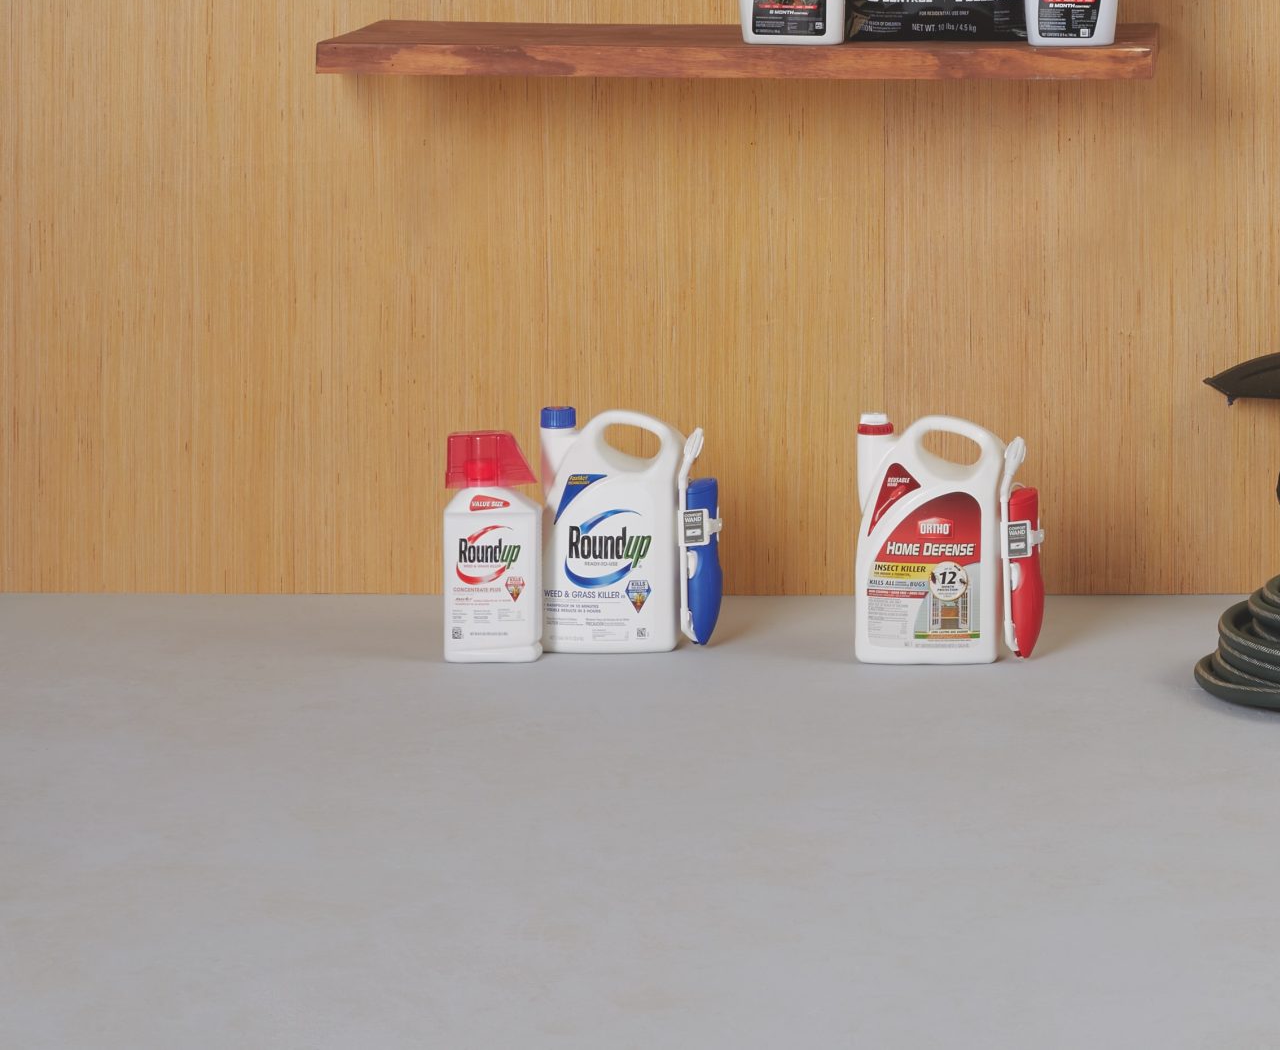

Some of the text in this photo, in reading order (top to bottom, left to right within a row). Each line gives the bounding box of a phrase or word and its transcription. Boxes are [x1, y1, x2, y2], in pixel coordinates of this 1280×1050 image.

[926, 24, 936, 32] WT.
[946, 23, 954, 31] lbs
[959, 23, 968, 31] 4.5
[968, 24, 977, 33] kg
[920, 523, 950, 535] ORTHO
[459, 538, 521, 569] Roundup
[568, 526, 652, 568] Roundup
[886, 541, 974, 556] HOME DEFENSE
[874, 564, 926, 573] INSECT KILLER
[939, 571, 957, 585] 12
[544, 589, 562, 598] WEED
[564, 590, 569, 598] &
[571, 590, 596, 598] GRASS
